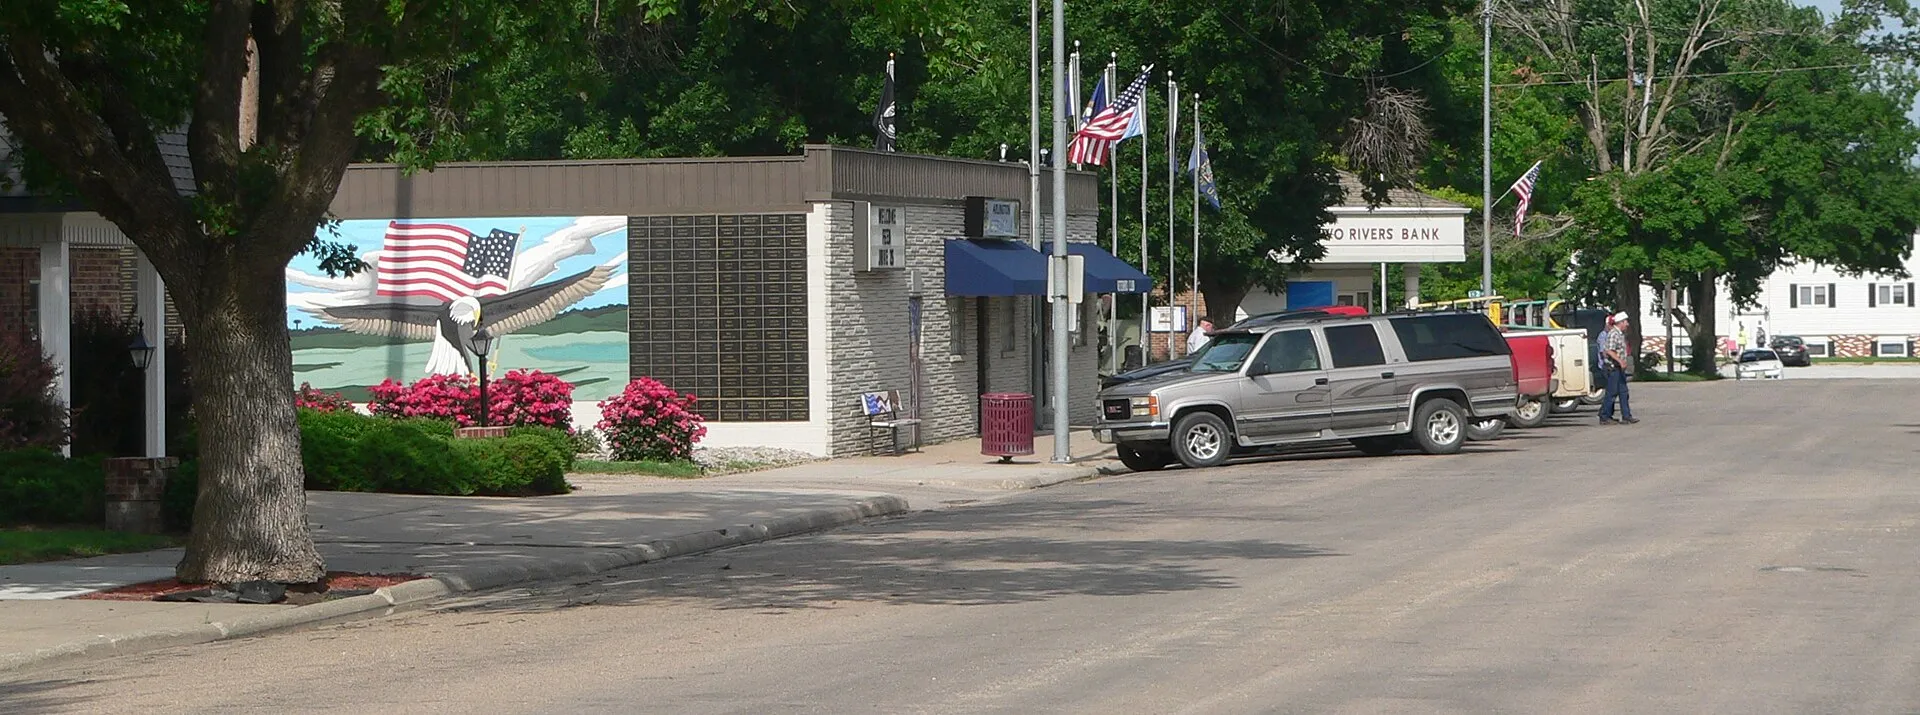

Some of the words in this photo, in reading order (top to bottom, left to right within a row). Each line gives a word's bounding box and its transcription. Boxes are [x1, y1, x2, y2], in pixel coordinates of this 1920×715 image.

[879, 208, 897, 225] WELCOME
[1349, 228, 1393, 241] RIVERS
[1401, 228, 1440, 241] BANK
